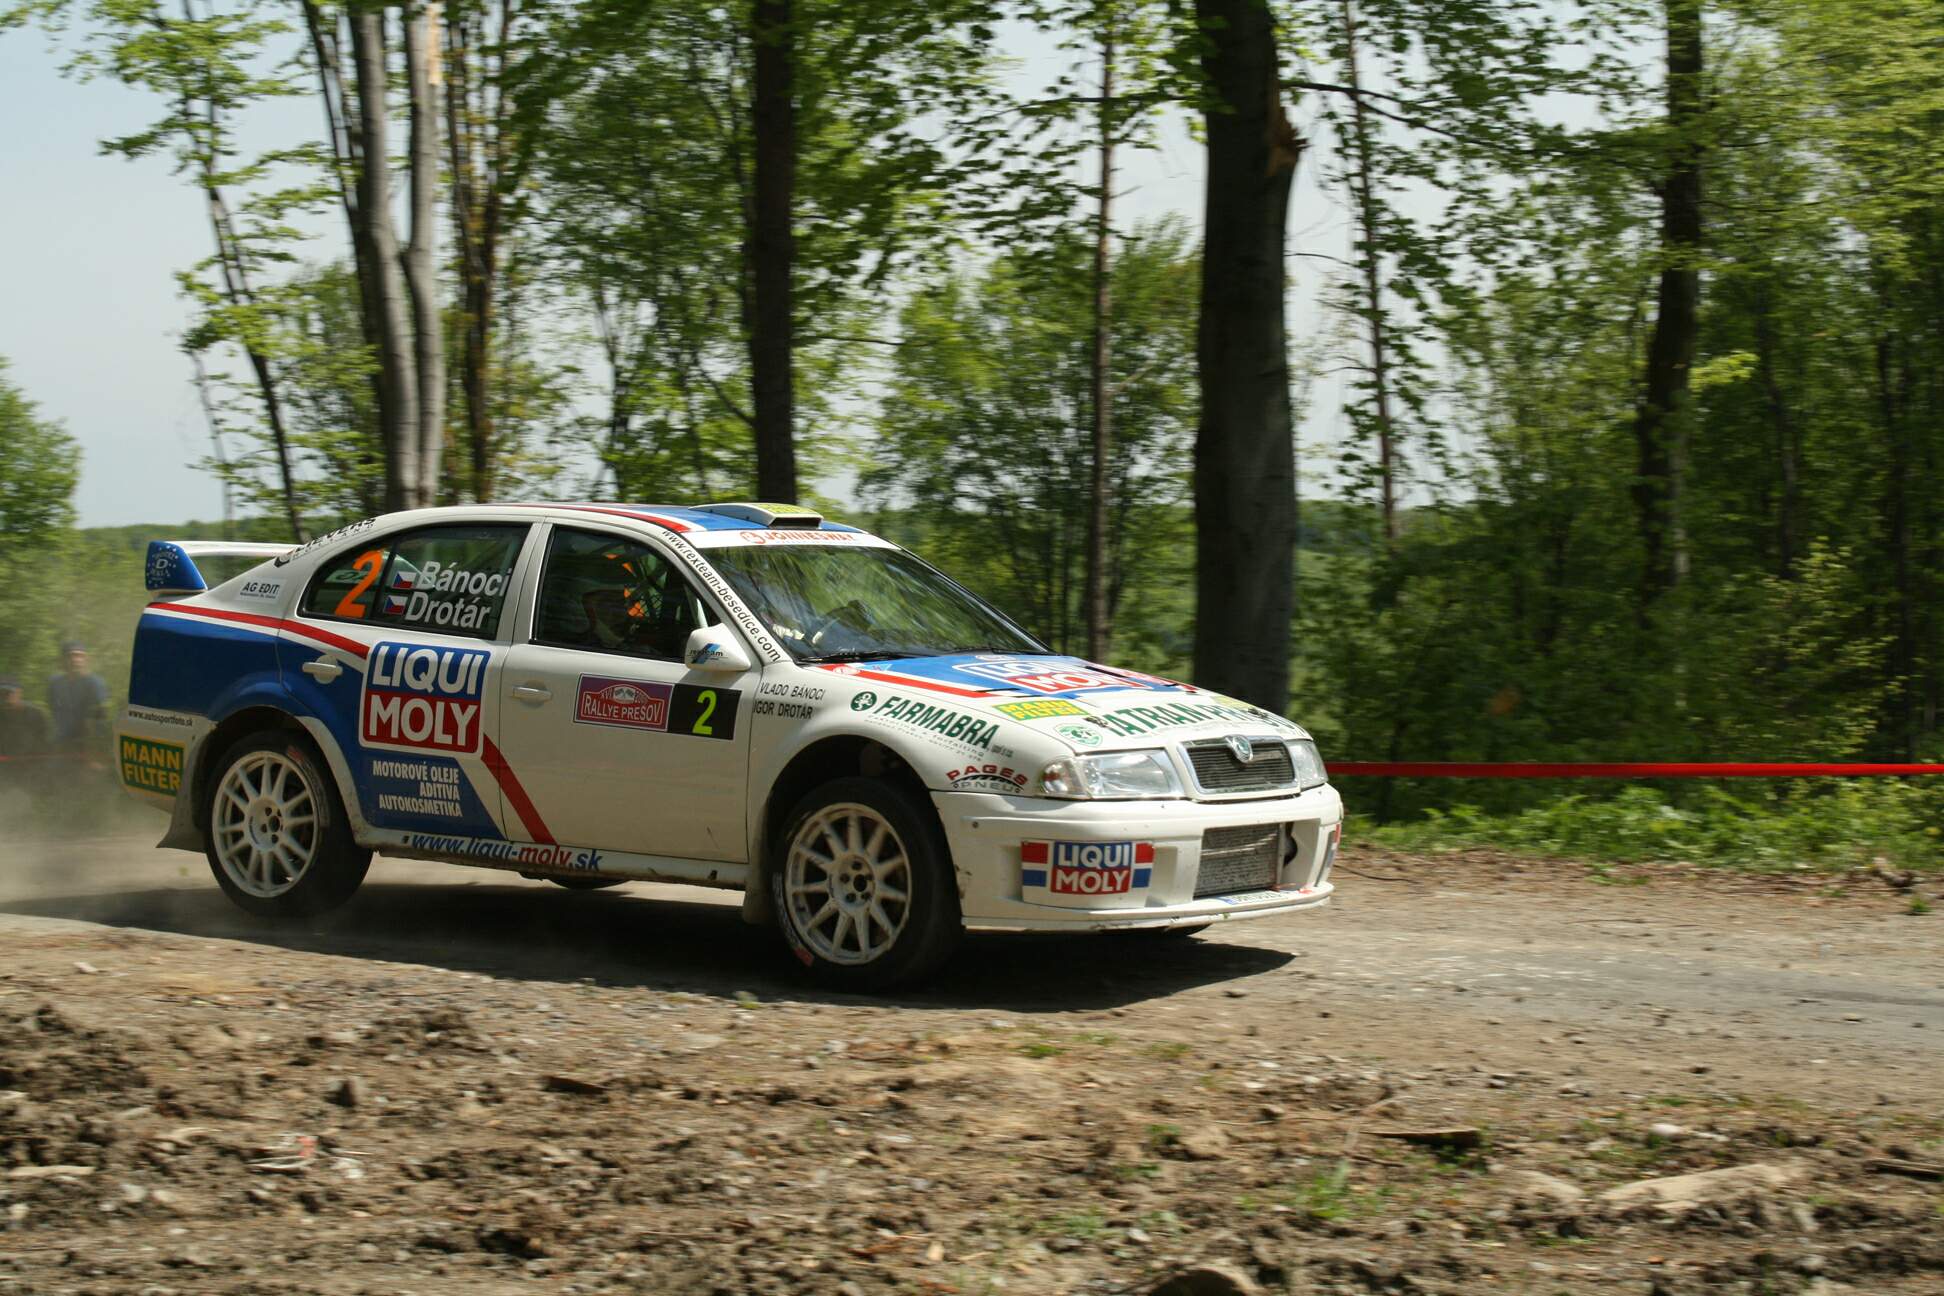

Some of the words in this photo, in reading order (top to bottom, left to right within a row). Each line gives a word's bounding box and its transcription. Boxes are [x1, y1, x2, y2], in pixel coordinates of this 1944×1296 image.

[243, 581, 260, 592] AG
[261, 583, 281, 595] EDIT
[335, 549, 384, 618] 2
[416, 560, 512, 597] Bánoci
[662, 530, 781, 662] www.rexteam-besedice.com
[405, 592, 492, 629] Drotár
[372, 645, 484, 695] LIQUI
[760, 682, 789, 696] VLADO
[584, 693, 620, 718] RALLYE
[692, 690, 716, 735] 2
[753, 700, 775, 716] IGOR
[369, 694, 478, 746] MOLY
[873, 696, 1000, 749] FARMABRA
[123, 741, 180, 769] MANN
[123, 763, 180, 789] FILTER
[372, 760, 428, 780] MOTOROVÉ
[430, 766, 459, 783] OLEJE
[946, 764, 1029, 786] PAGES
[419, 782, 460, 801] ADITIVA
[961, 780, 1014, 792] PNEU
[379, 794, 463, 817] AUTOKOSMETIKA
[1058, 844, 1129, 869] LIQUI
[1055, 869, 1130, 892] MOLY
